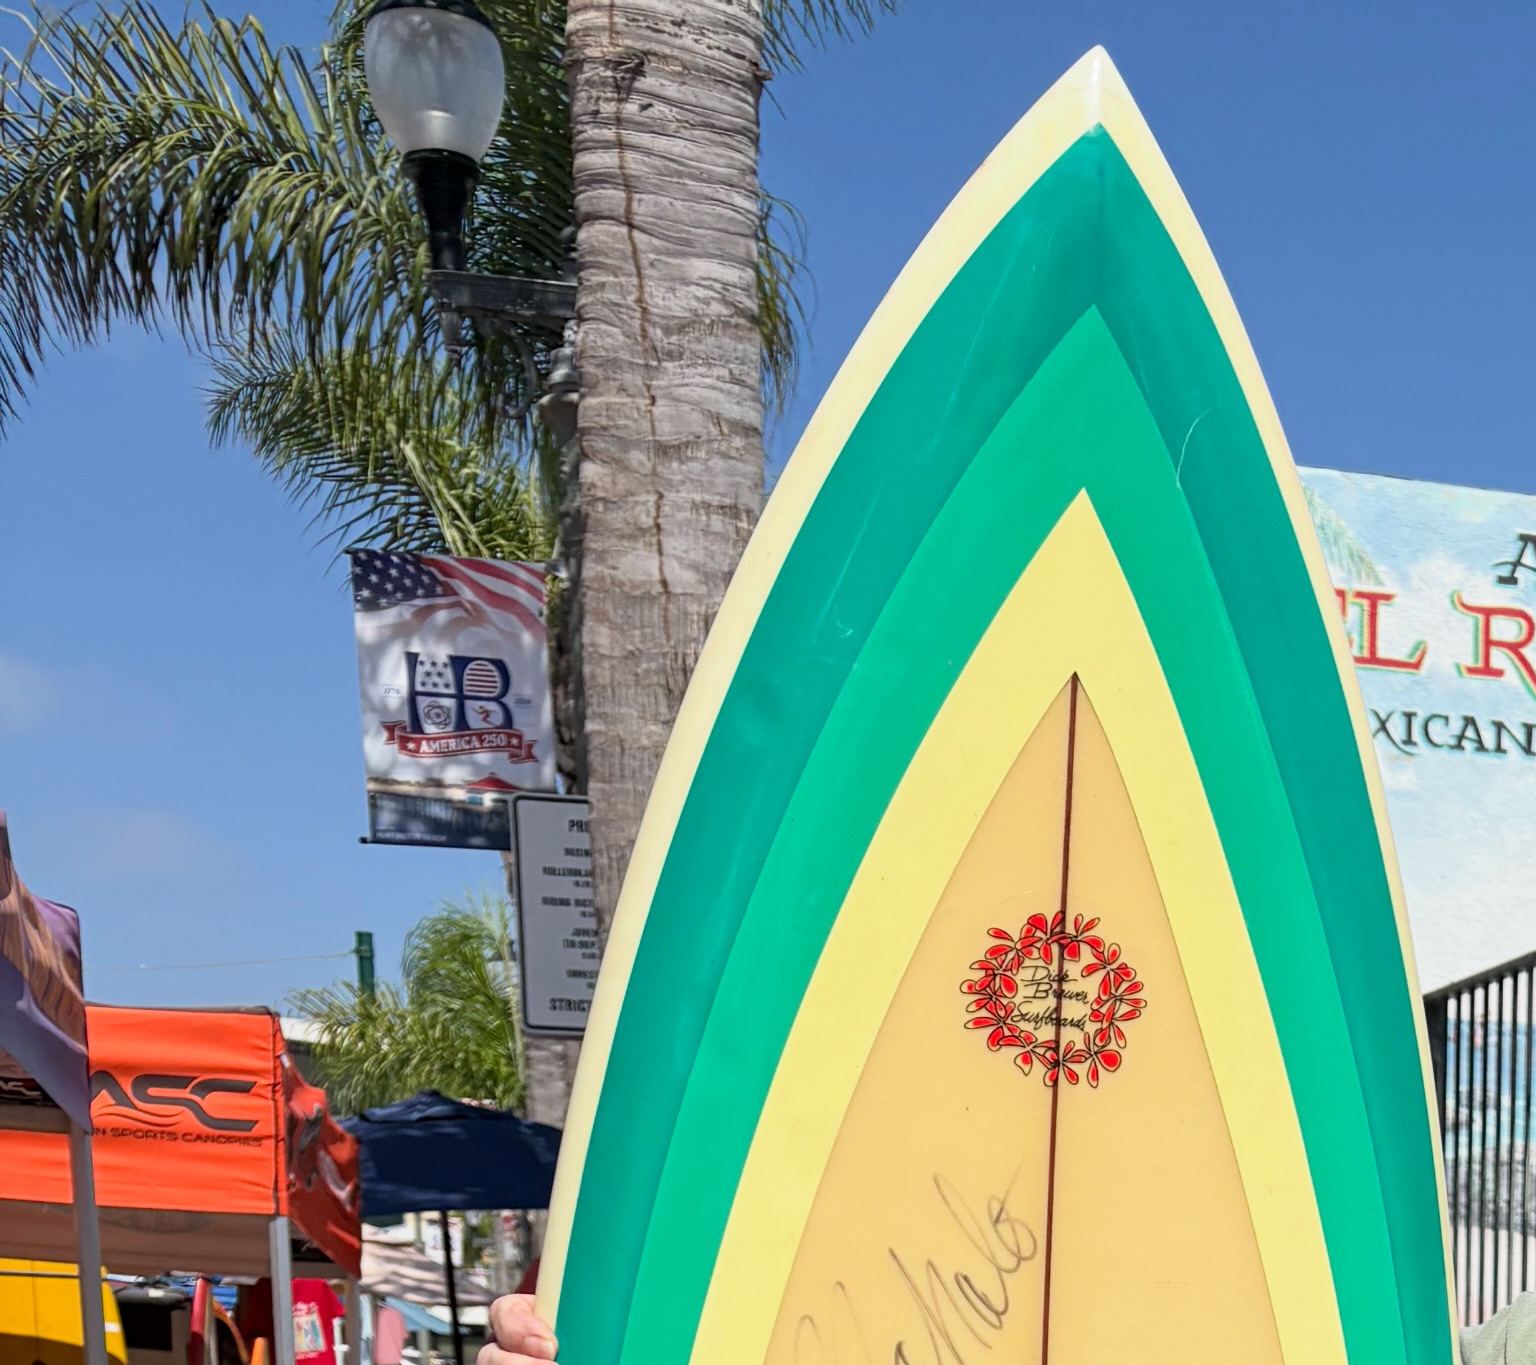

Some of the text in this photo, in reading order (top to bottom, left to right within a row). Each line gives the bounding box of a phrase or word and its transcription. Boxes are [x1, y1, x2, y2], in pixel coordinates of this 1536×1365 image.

[420, 733, 508, 754] AMERICA 250
[1010, 1001, 1088, 1032] Surfboards
[111, 1128, 179, 1142] SPORTS
[181, 1132, 264, 1147] CANOPIES
